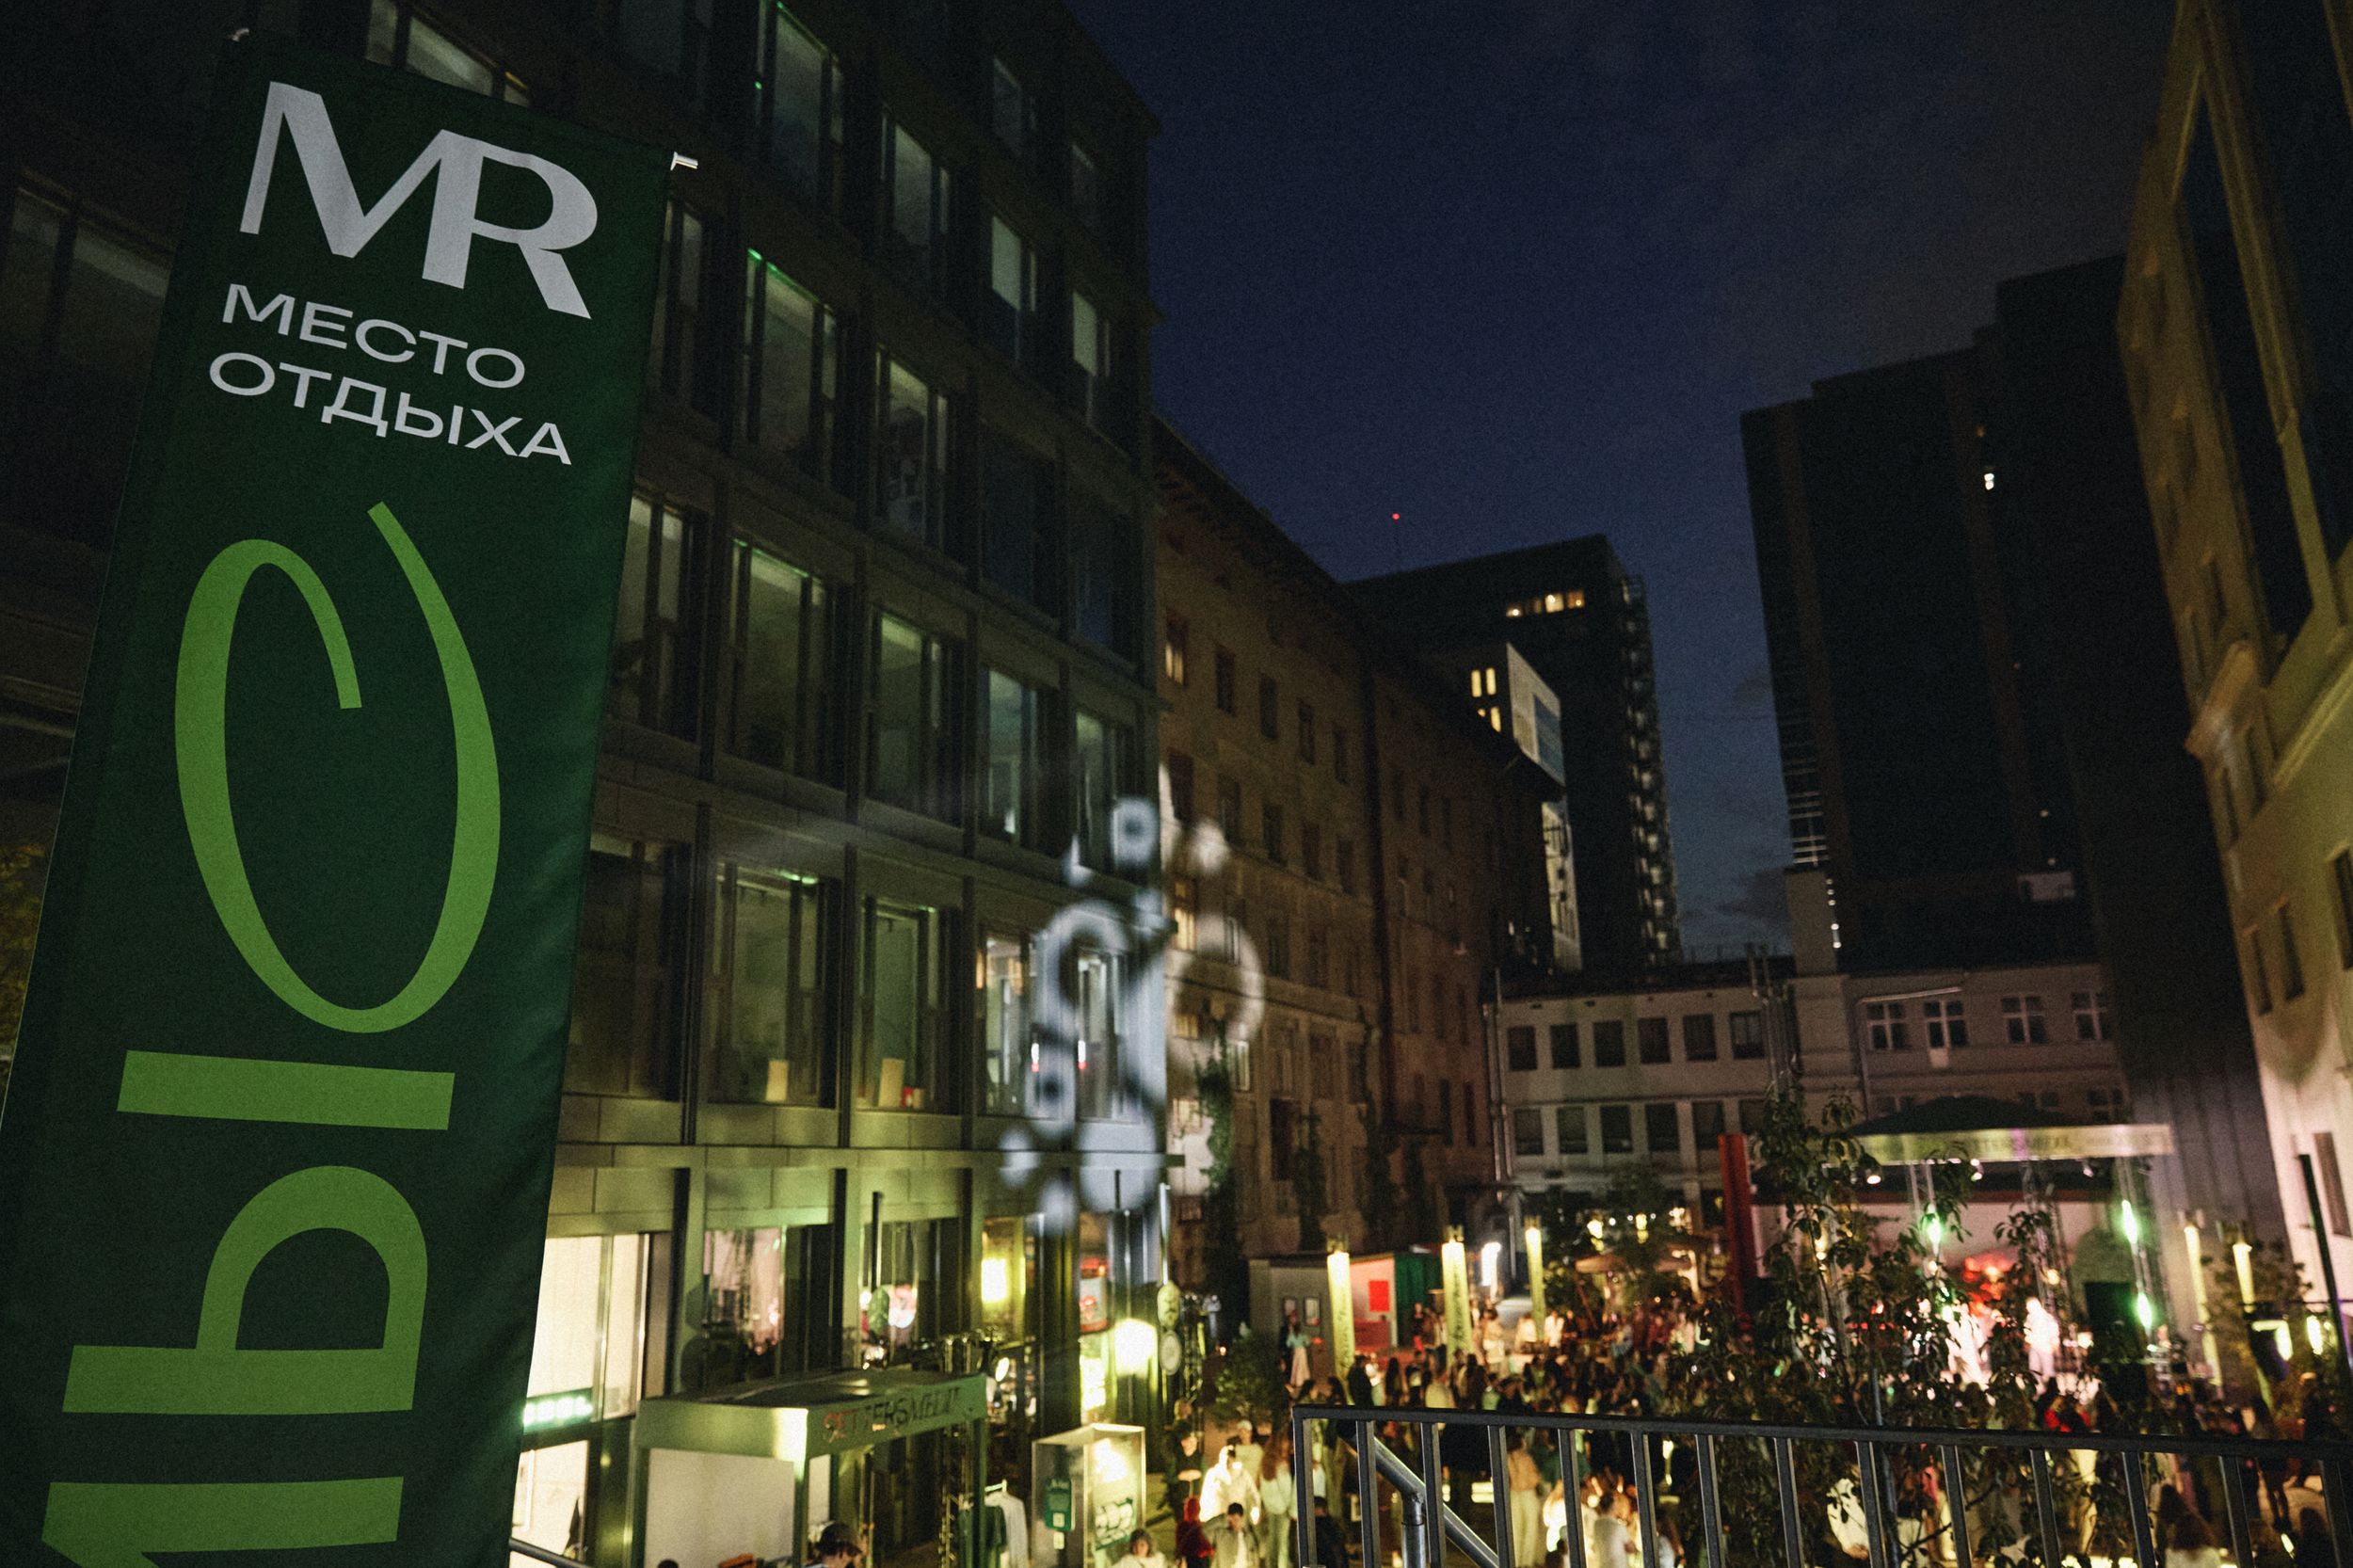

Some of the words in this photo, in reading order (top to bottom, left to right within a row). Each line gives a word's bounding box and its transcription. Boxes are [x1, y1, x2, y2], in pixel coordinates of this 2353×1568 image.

[240, 81, 599, 320] MR
[222, 283, 526, 390] МЕСТО
[209, 352, 573, 466] ОТДЫХА
